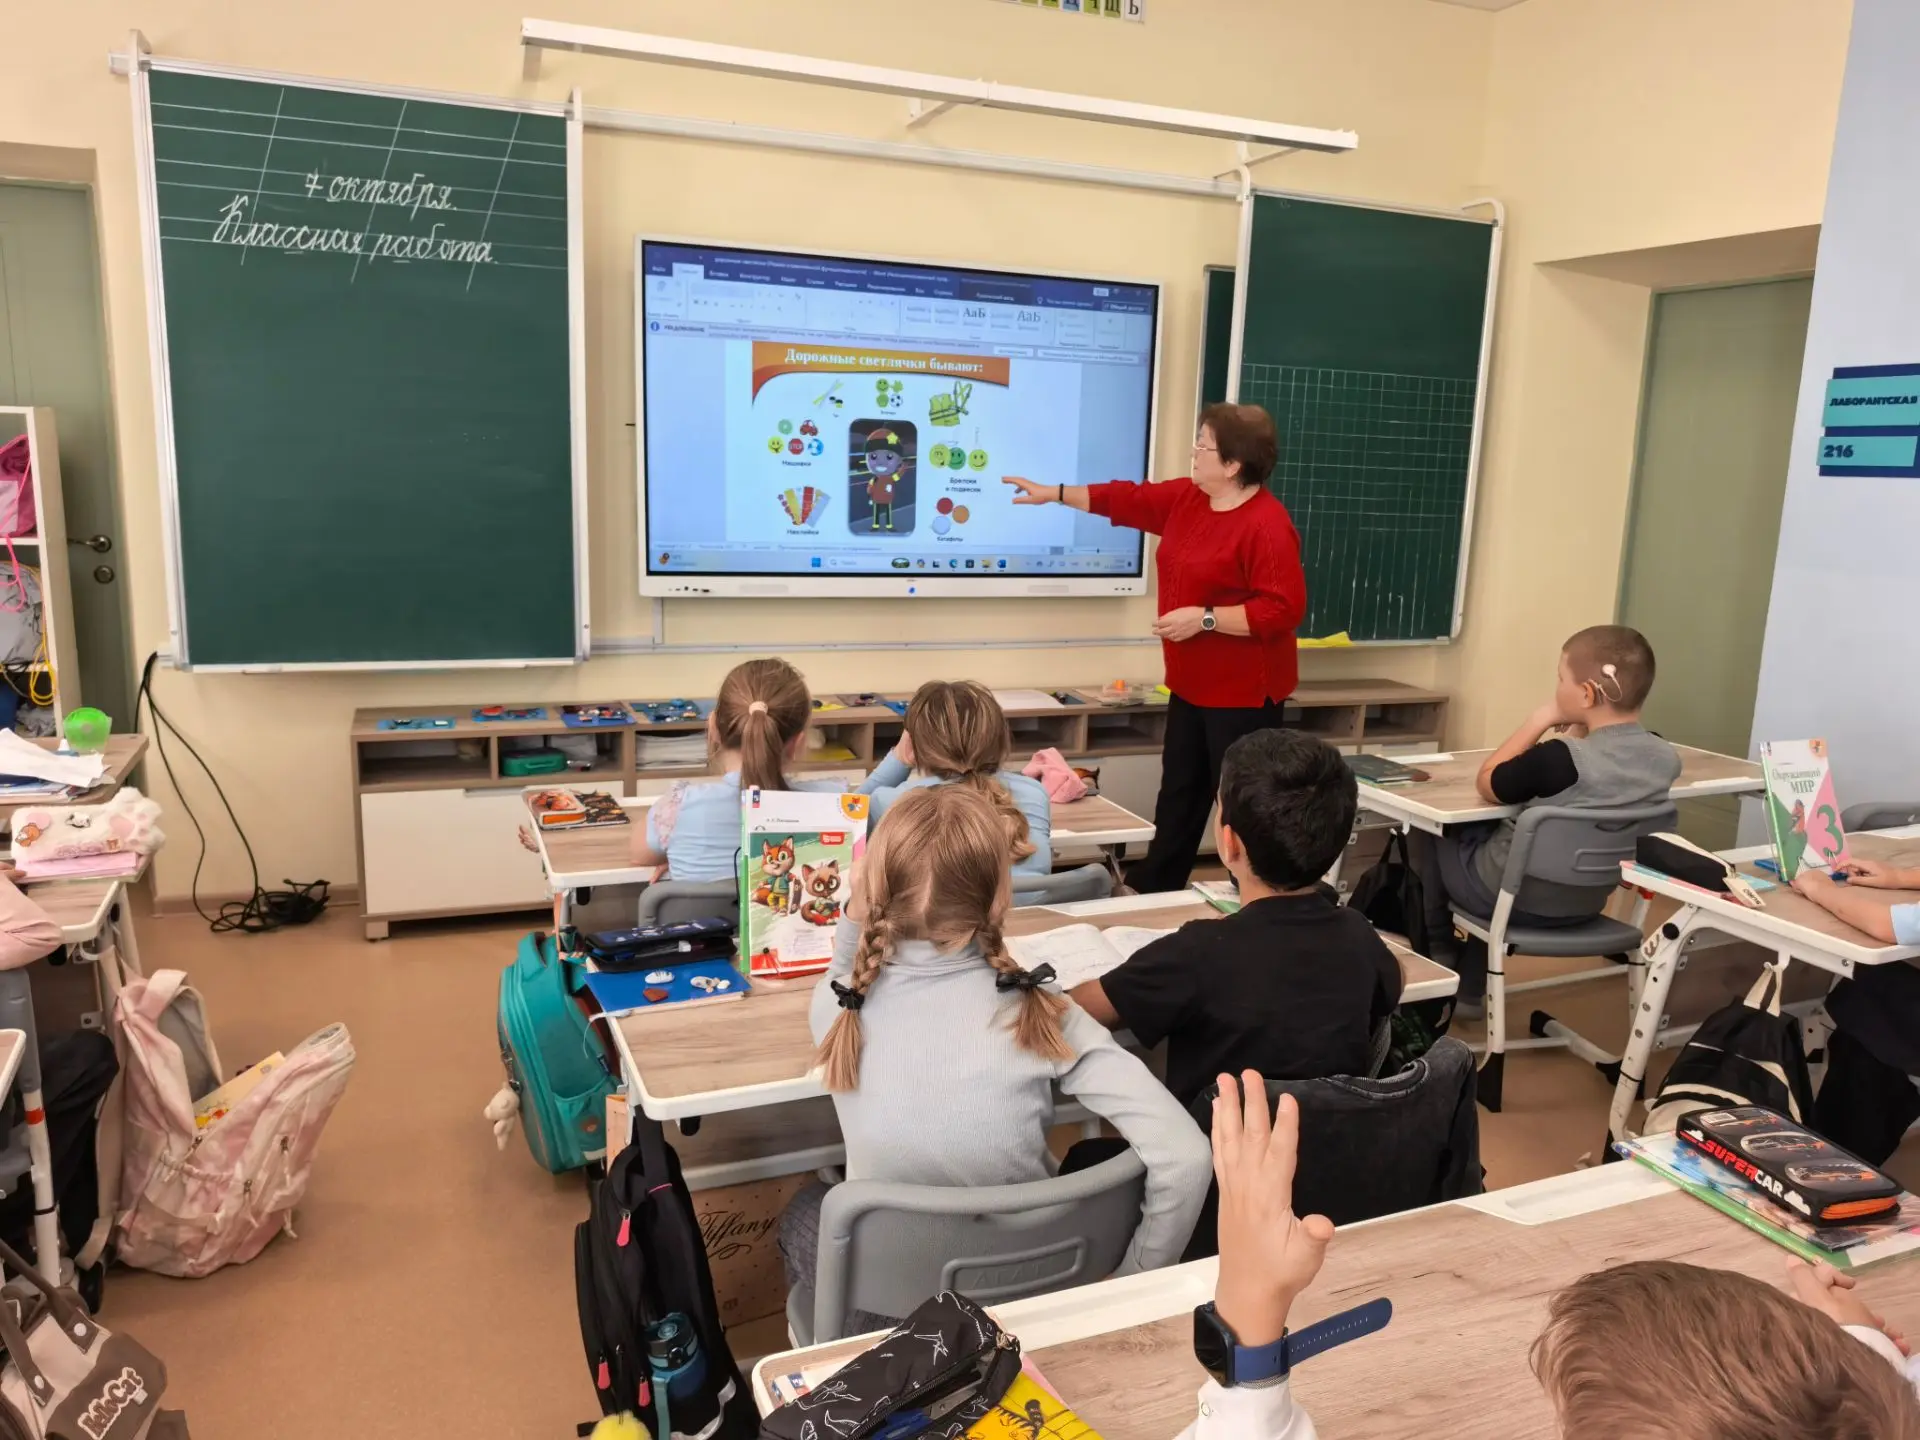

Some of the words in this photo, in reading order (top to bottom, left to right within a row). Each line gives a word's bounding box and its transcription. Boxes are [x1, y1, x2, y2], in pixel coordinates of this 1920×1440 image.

[305, 172, 323, 198] 7
[212, 194, 362, 253] Классная
[784, 348, 857, 365] Дорожные
[858, 356, 926, 369] светлячки
[929, 358, 984, 373] бывают:
[1829, 395, 1918, 407] ЛАБОРАНТСКАЯ
[1823, 445, 1854, 458] 216
[1816, 804, 1844, 857] 3
[697, 1210, 777, 1252] Tiffany
